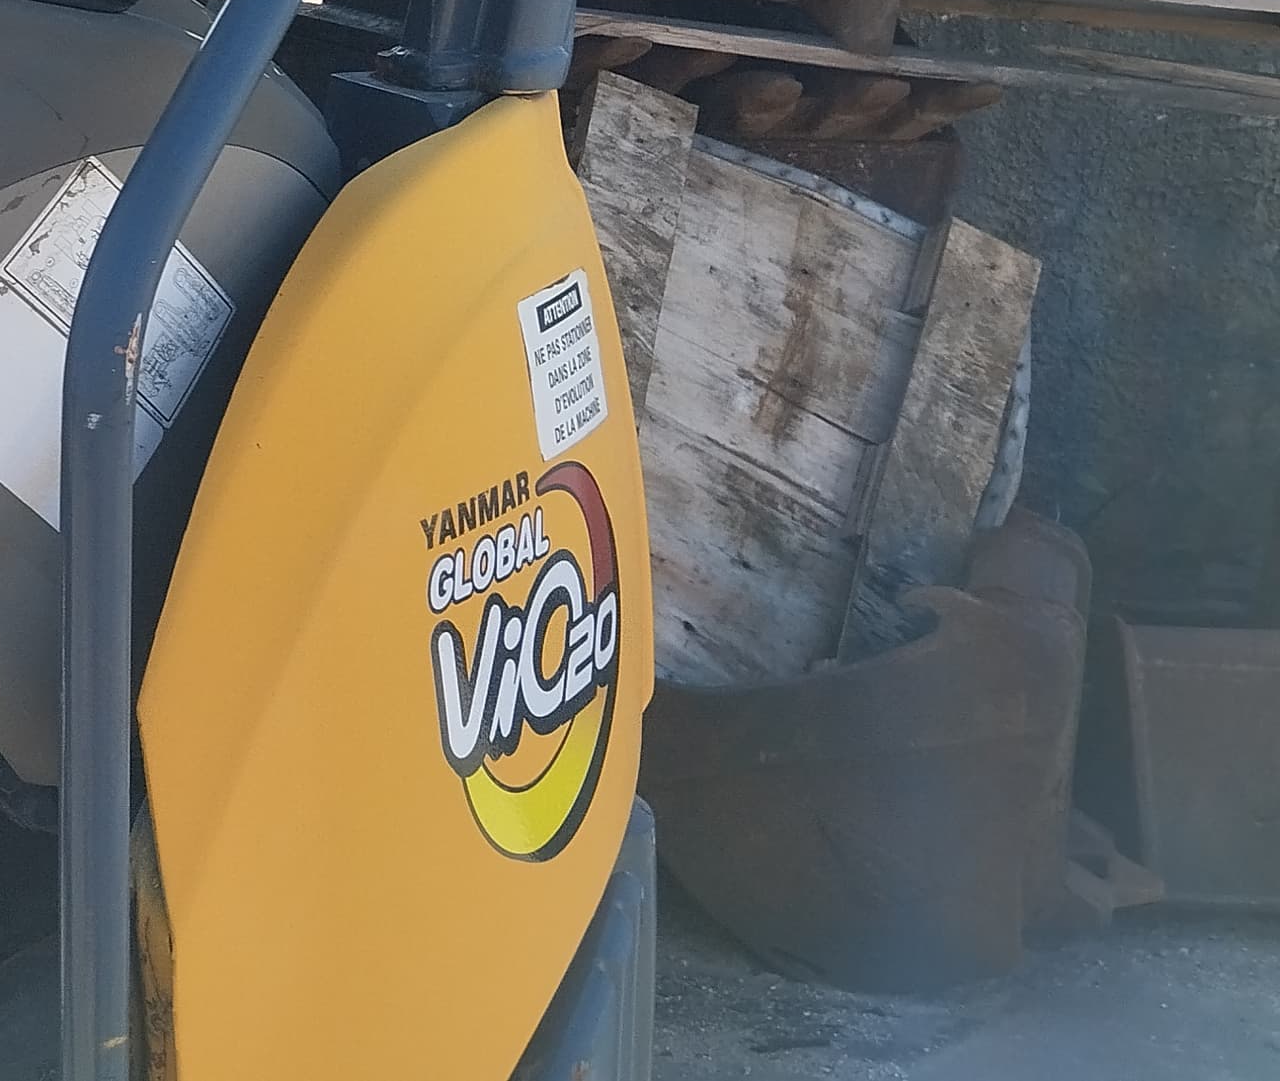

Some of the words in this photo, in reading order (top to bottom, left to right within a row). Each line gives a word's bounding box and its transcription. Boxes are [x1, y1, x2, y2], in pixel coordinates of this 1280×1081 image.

[542, 288, 579, 326] ATTENTION
[534, 347, 546, 367] NE
[546, 338, 561, 361] PAS
[560, 315, 593, 351] STATIONNER
[547, 363, 568, 388] DANS
[568, 357, 578, 376] LA
[577, 346, 593, 370] ZONE
[554, 423, 566, 444] DE
[566, 418, 577, 437] LA
[575, 397, 601, 430] MACHINE
[420, 471, 530, 550] YANMAR
[428, 507, 550, 612] GLOBAL
